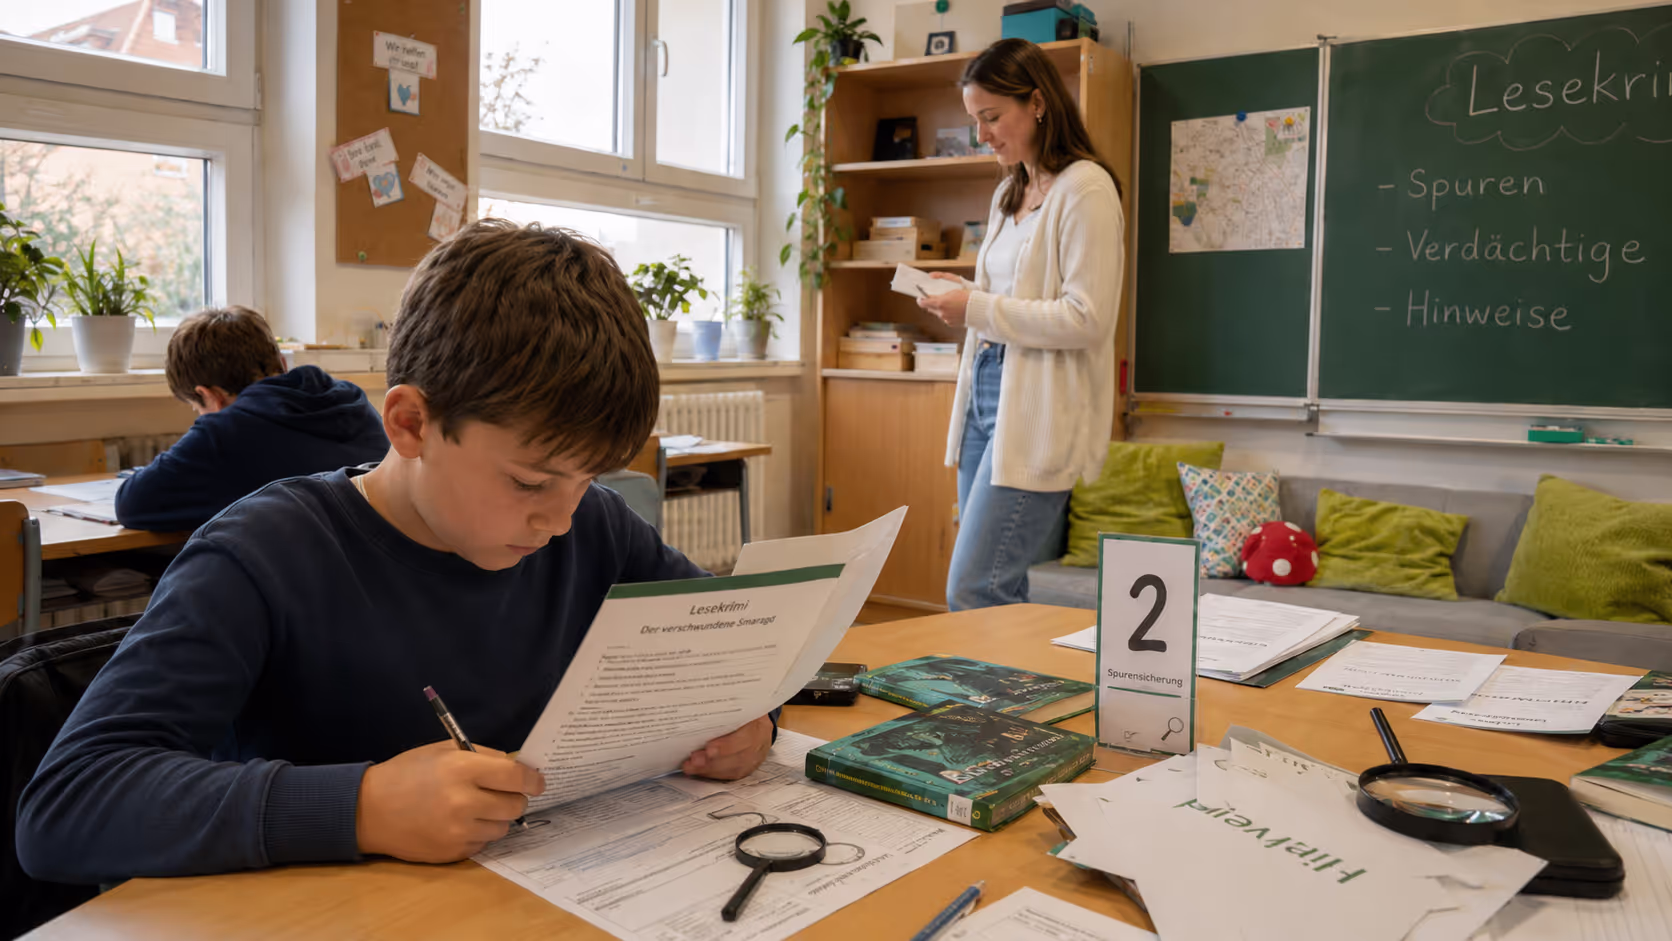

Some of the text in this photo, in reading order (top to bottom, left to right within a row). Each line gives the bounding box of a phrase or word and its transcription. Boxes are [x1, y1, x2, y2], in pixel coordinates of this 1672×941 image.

[1469, 50, 1672, 116] Lesekri
[1408, 168, 1545, 211] Spuren
[1407, 226, 1646, 284] Verdächtige
[1407, 289, 1572, 330] Hinweise
[639, 624, 662, 635] Der
[661, 619, 737, 634] verschwundene
[689, 599, 749, 616] Lesekrimi
[1128, 573, 1168, 653] 2
[1107, 667, 1184, 688] Spurensicherung
